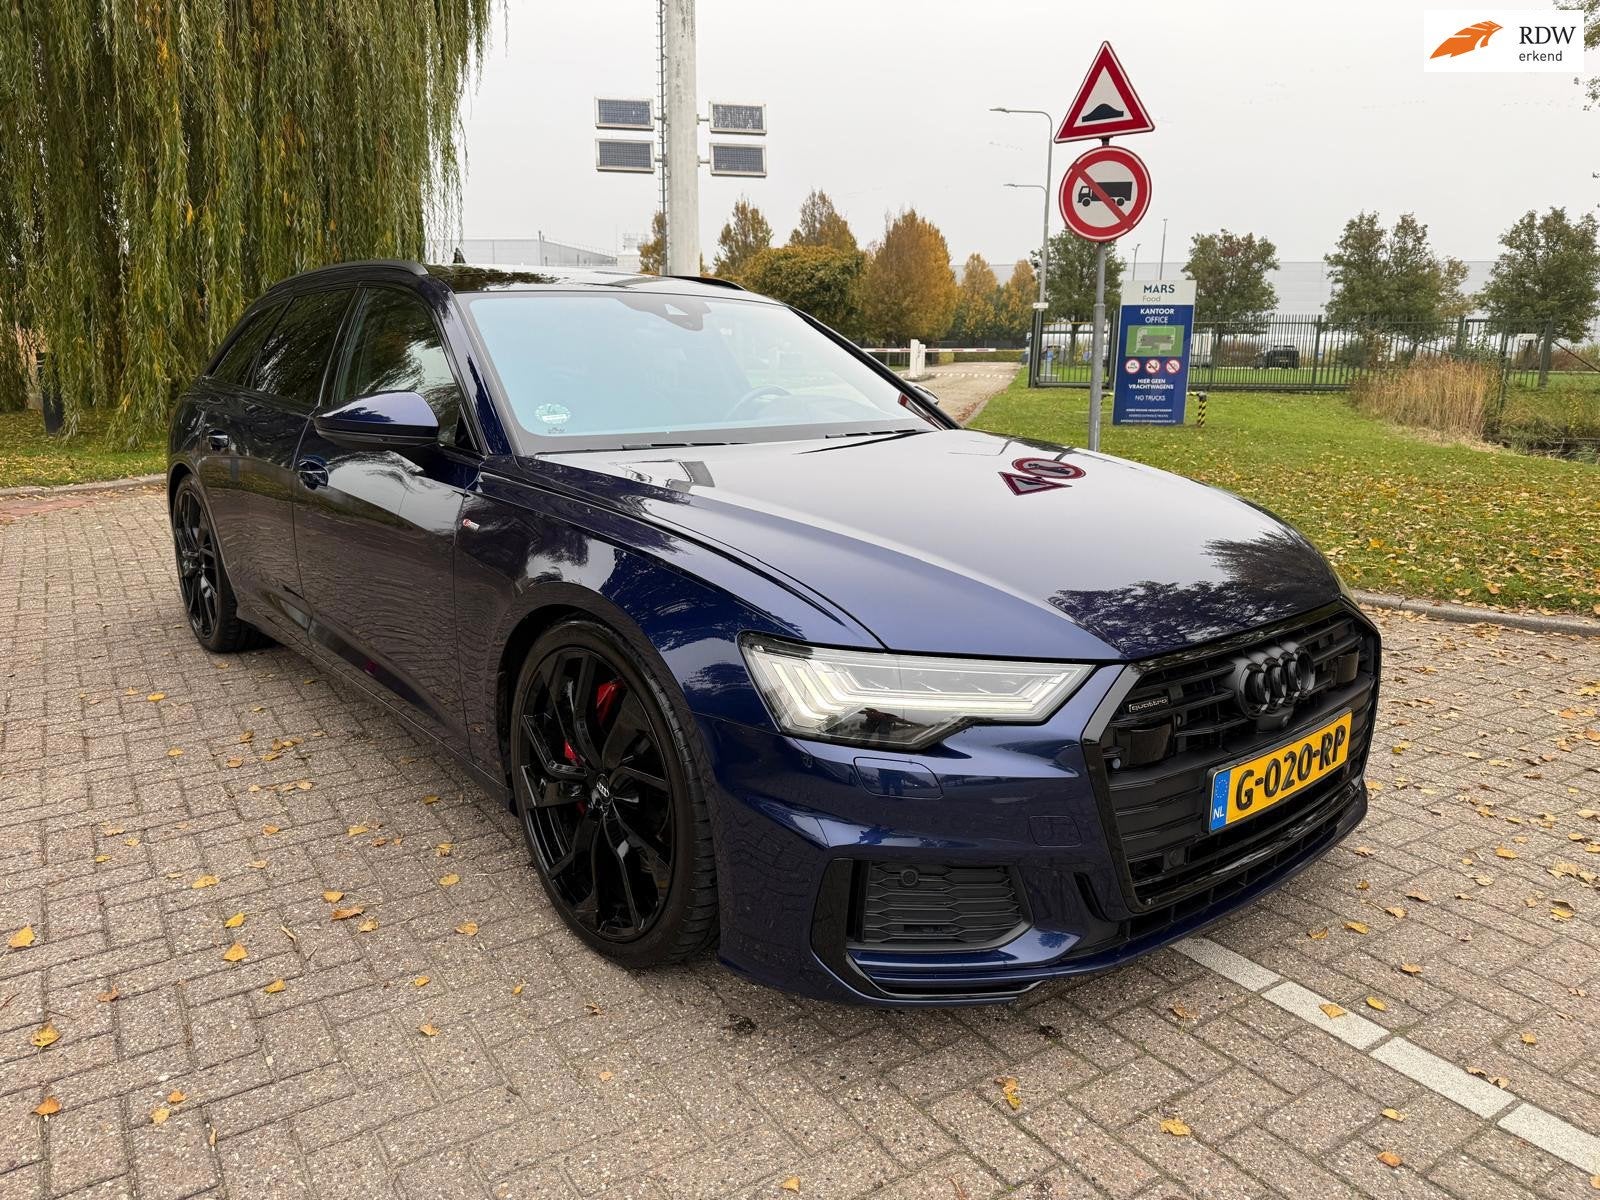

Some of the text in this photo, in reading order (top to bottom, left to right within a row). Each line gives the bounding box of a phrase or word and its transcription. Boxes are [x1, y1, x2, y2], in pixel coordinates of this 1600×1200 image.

[1143, 284, 1175, 294] MARS
[1144, 316, 1169, 324] OFFICE
[1235, 724, 1346, 811] G-020-RP
[1212, 805, 1225, 820] NL
